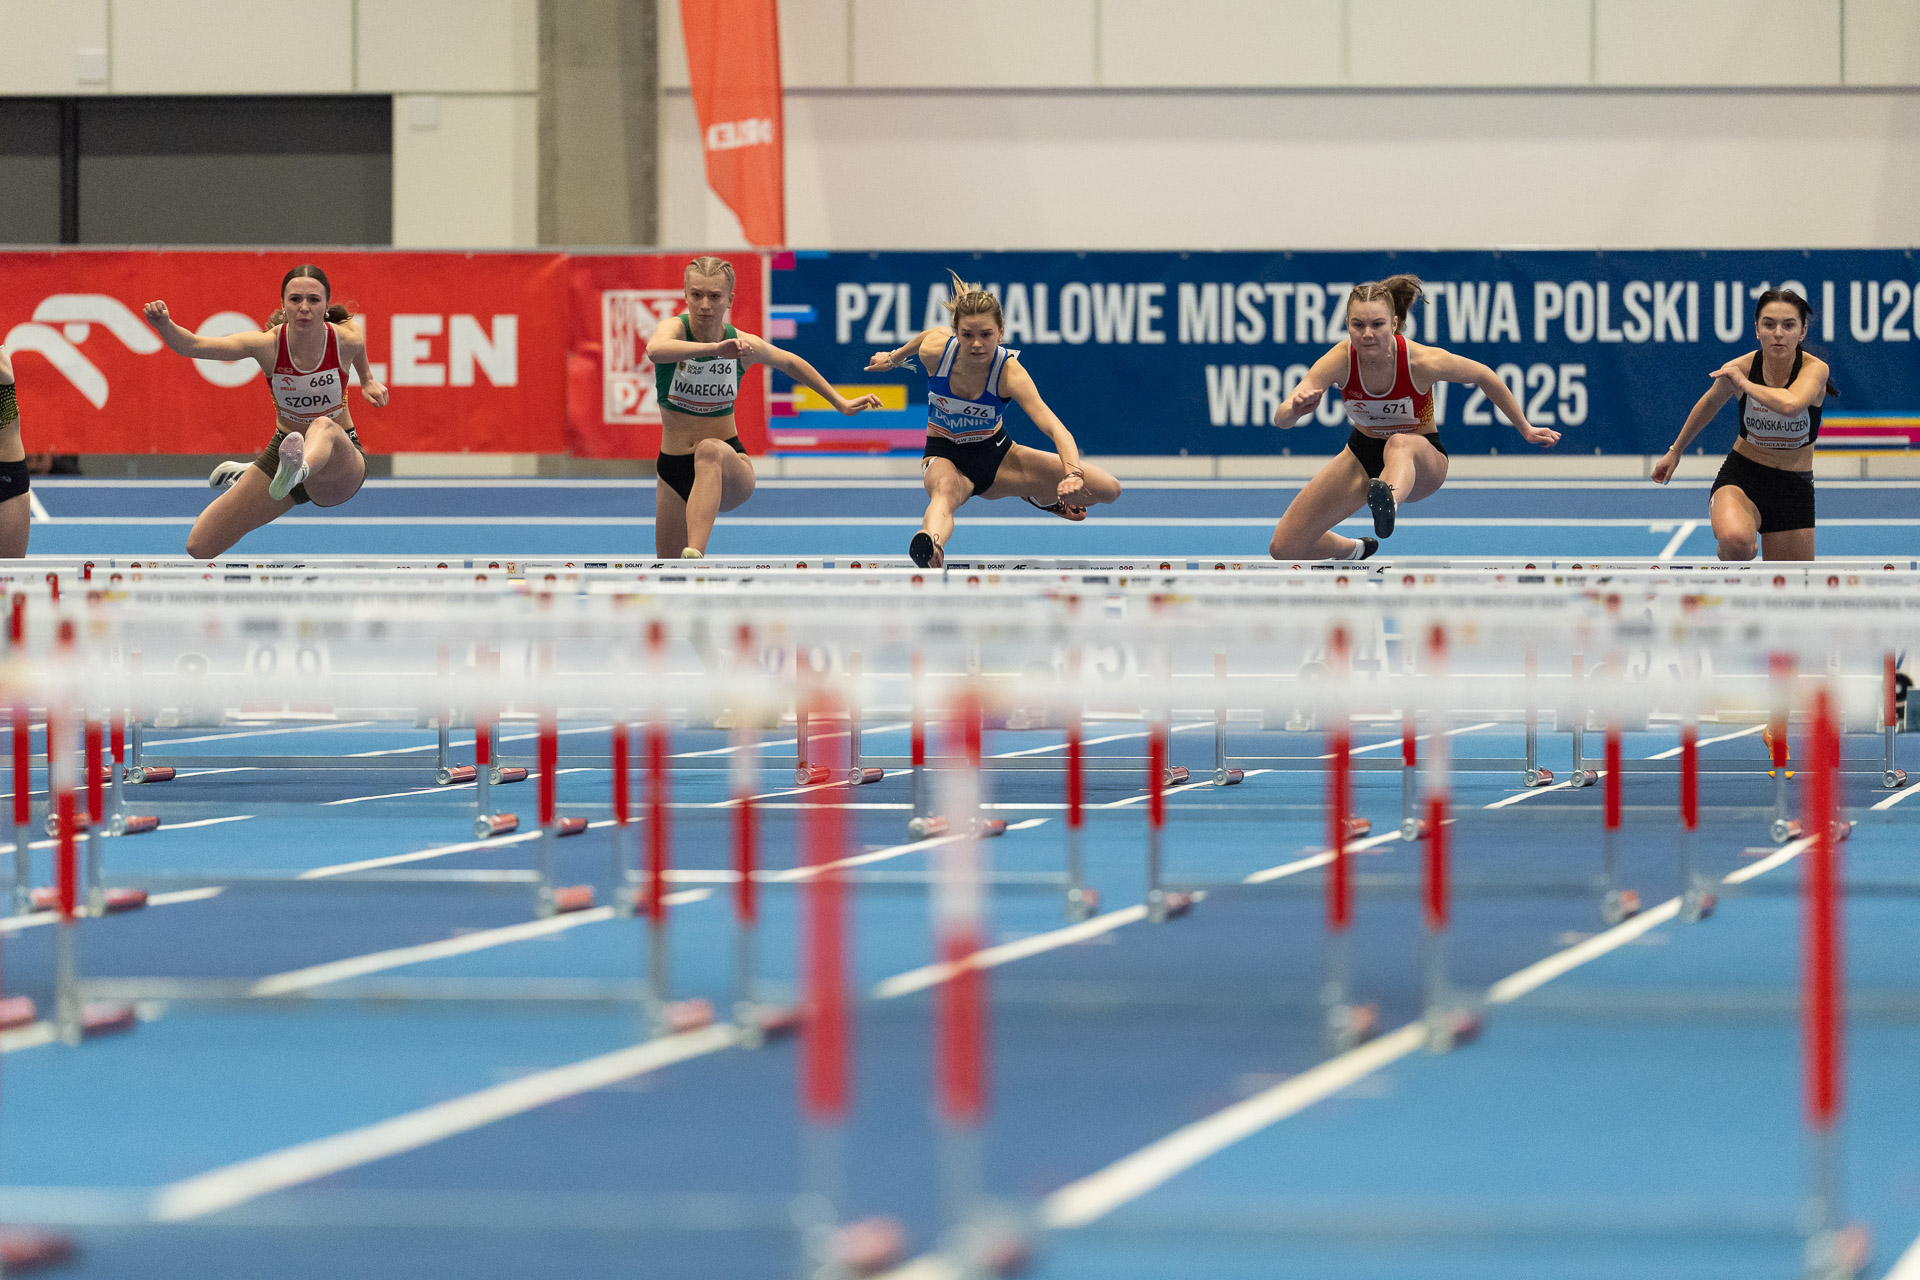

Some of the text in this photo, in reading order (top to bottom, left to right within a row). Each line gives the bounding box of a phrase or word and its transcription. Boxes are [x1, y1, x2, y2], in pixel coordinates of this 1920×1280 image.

[985, 282, 1167, 344] ALOWE
[1178, 281, 1521, 344] MISTRZTWA
[1534, 281, 1699, 344] POLSKI
[1823, 281, 1835, 342] I
[1850, 281, 1920, 342] U2
[193, 311, 518, 388] OLEN
[709, 363, 732, 375] 436
[310, 374, 335, 388] 668
[674, 379, 735, 397] WARECKA
[285, 394, 332, 408] SZOPA
[963, 406, 989, 418] 676
[1382, 403, 1408, 415] 671
